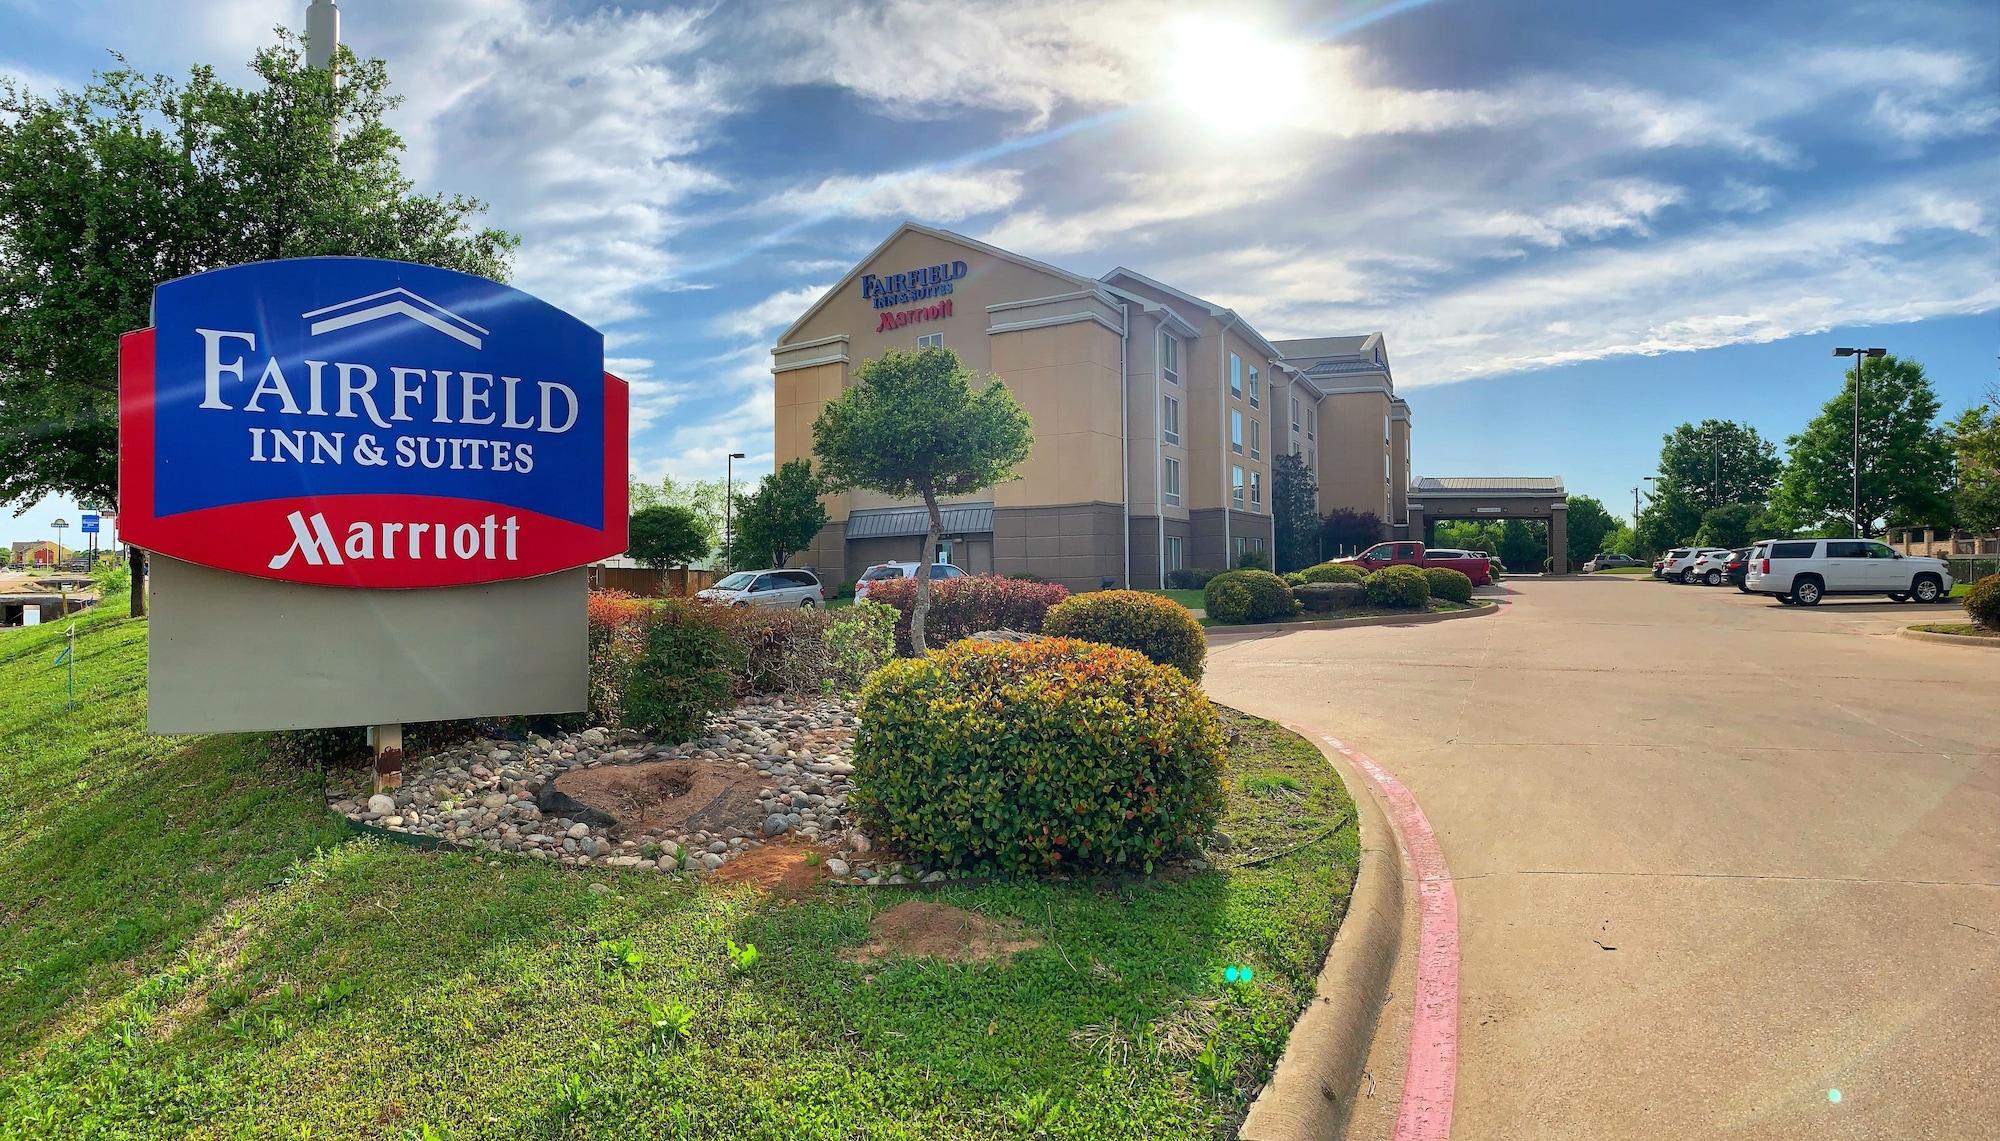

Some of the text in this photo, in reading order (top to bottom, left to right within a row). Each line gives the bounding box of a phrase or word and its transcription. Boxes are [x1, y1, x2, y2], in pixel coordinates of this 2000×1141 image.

[860, 260, 968, 299] FAIRFIELD
[873, 294, 898, 309] INN
[911, 282, 953, 302] SUITES
[876, 299, 953, 332] Marriott
[195, 328, 580, 434] FAIRFIELD
[248, 427, 535, 474] INN & SUITES
[267, 510, 521, 570] Marriott
